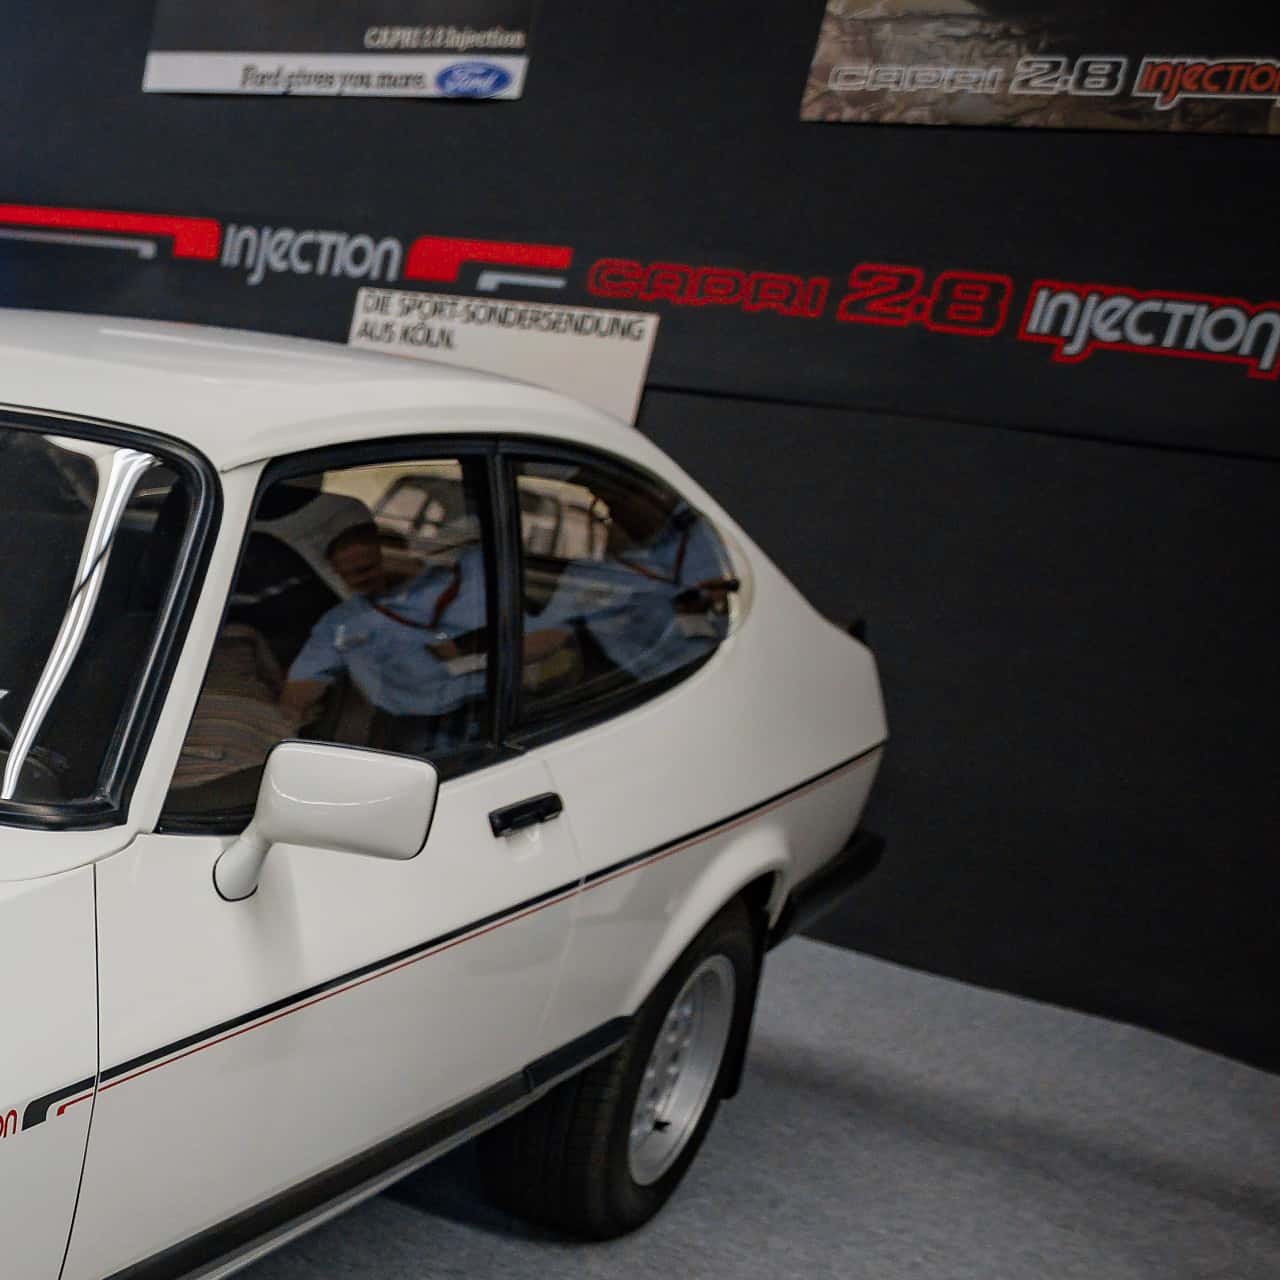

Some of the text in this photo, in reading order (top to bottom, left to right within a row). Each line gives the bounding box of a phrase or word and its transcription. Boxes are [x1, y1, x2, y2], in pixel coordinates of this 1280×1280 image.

[443, 64, 504, 94] Ford
[830, 63, 1003, 95] CAPRI
[1136, 58, 1280, 109] INJECTIO
[361, 290, 390, 314] DIE
[587, 258, 830, 318] CAPRI
[358, 320, 395, 344] AUS
